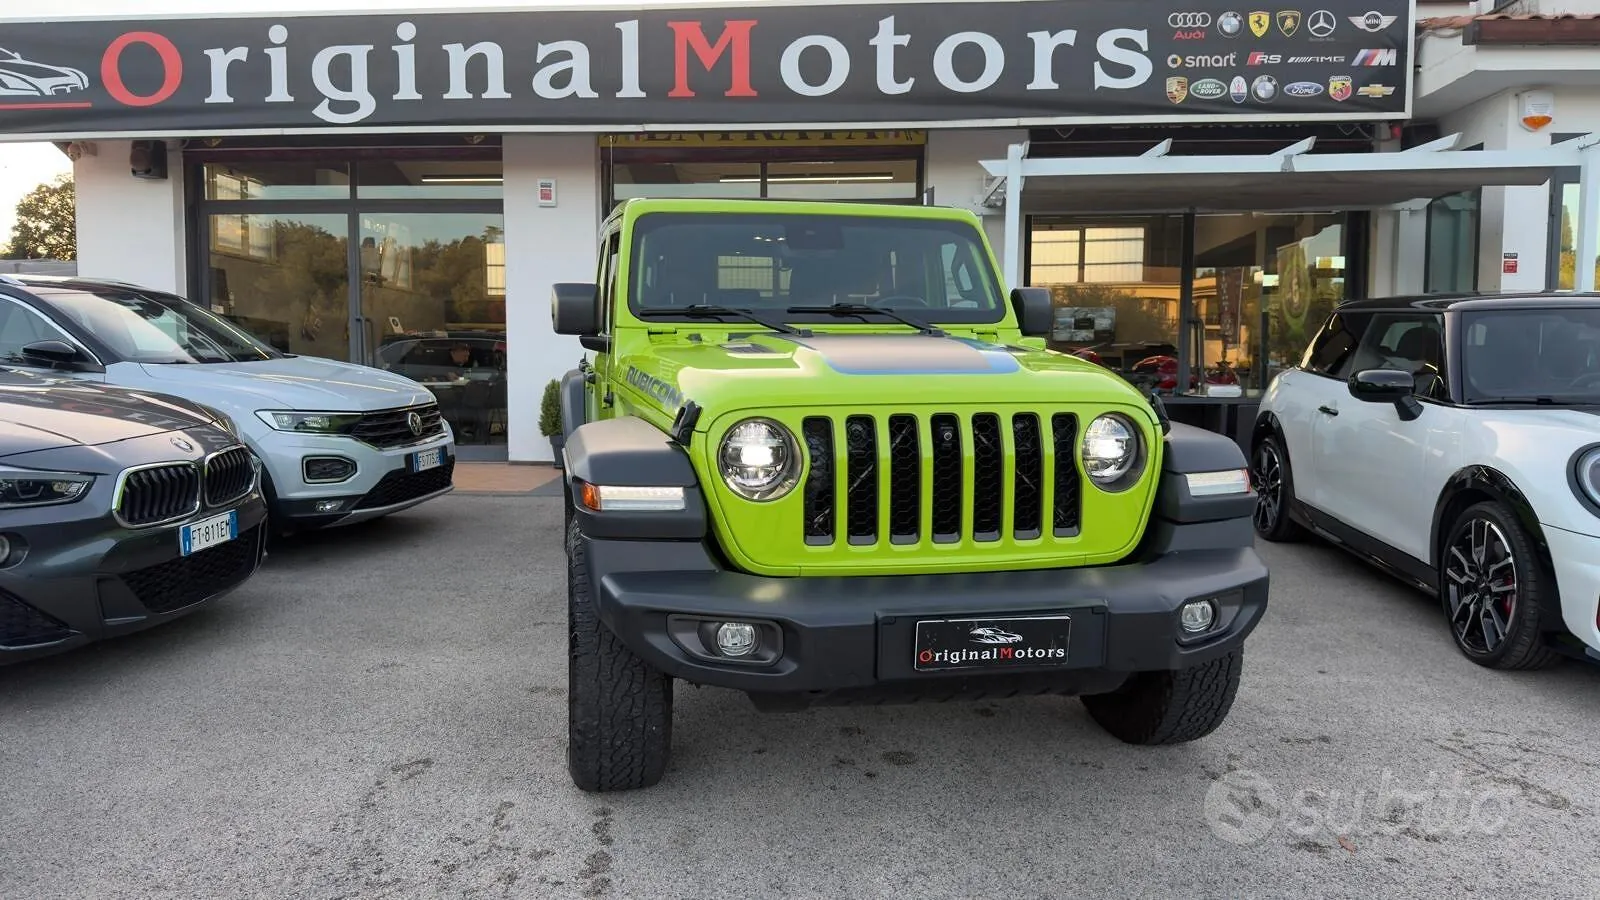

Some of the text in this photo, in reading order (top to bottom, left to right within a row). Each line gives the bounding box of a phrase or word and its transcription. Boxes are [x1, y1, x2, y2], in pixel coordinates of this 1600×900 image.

[1173, 30, 1206, 40] Audi
[1185, 53, 1236, 68] smart
[1291, 85, 1317, 95] Ford
